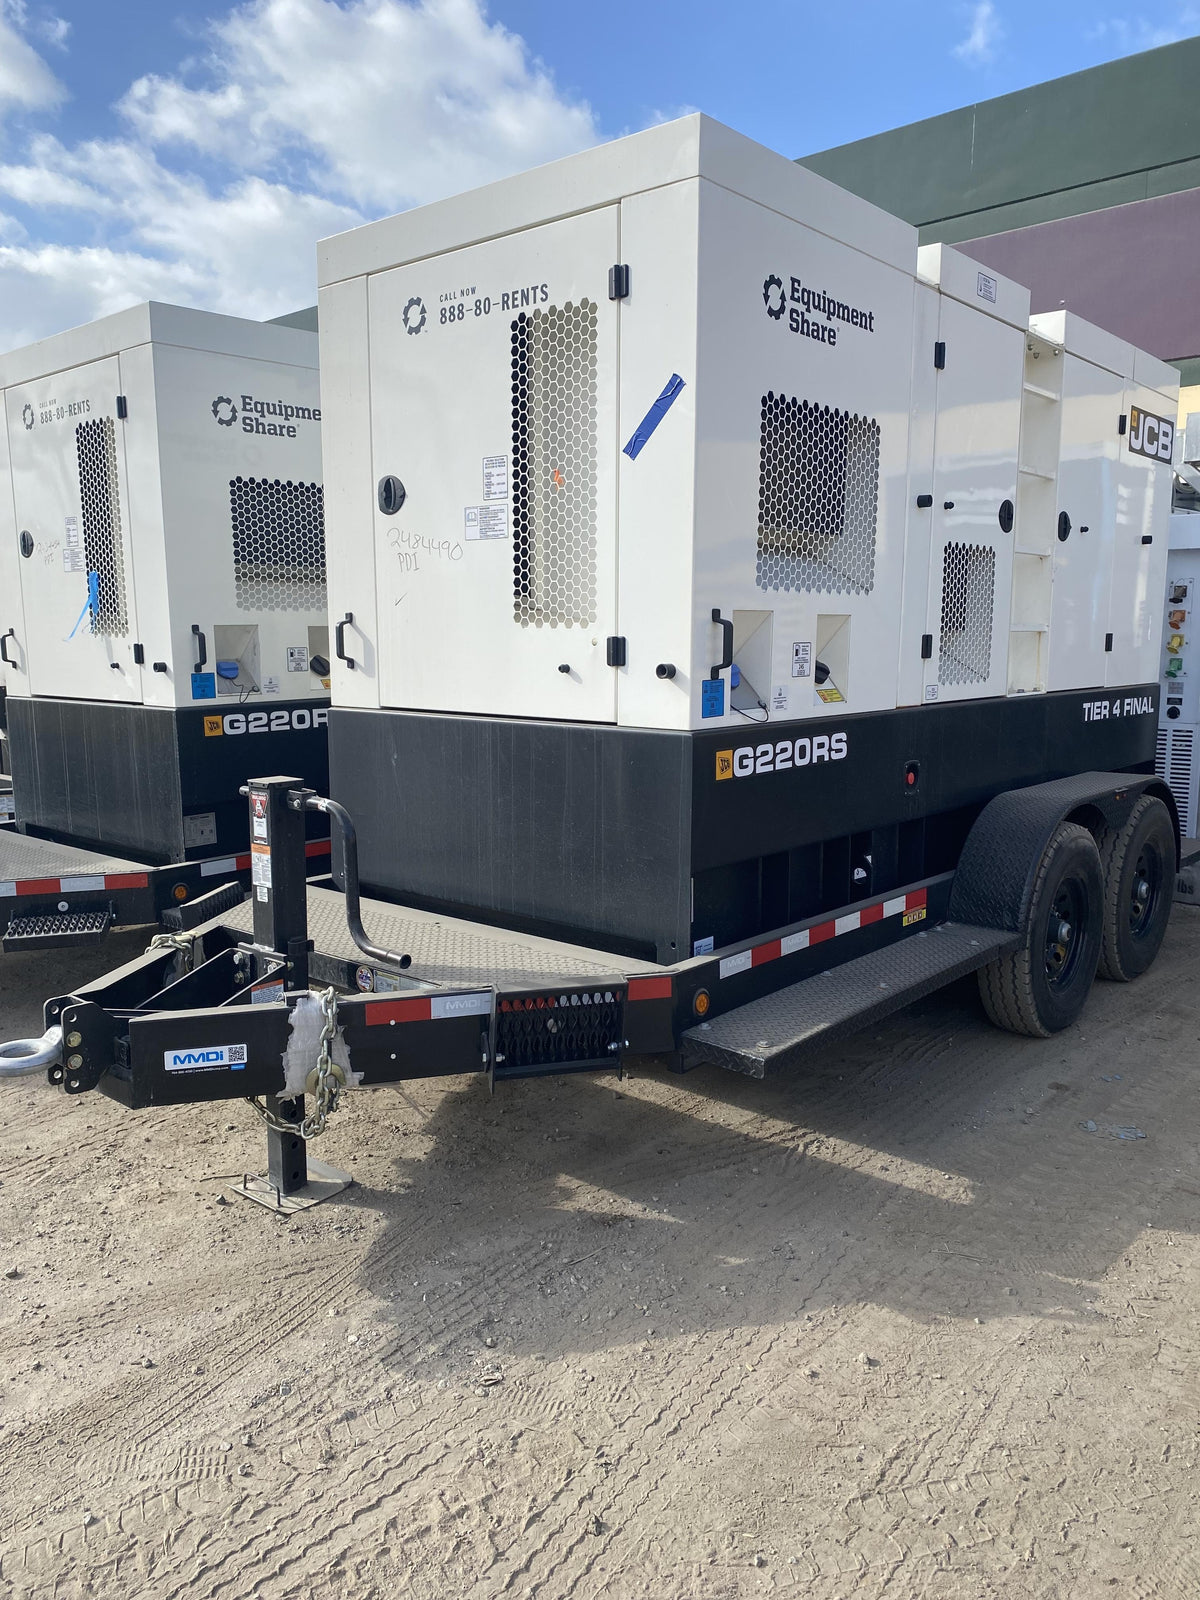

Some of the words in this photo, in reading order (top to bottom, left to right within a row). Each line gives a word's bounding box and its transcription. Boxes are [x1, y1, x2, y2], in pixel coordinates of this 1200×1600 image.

[440, 291, 457, 303] CALL
[460, 286, 477, 298] NOW
[440, 283, 549, 325] 888-80-RENTS
[789, 276, 875, 333] Equipment
[789, 307, 837, 347] Share
[40, 399, 91, 425] 888-80-RENTS
[241, 395, 322, 422] Equipme
[241, 416, 297, 439] Share
[1130, 412, 1173, 460] JCB
[386, 527, 463, 561] 2484490
[397, 552, 420, 573] PDI
[1082, 701, 1110, 722] TIER
[1112, 699, 1121, 717] 4
[1123, 696, 1155, 717] FINAL
[733, 732, 848, 778] G220RS
[1176, 878, 1194, 895] lbs
[172, 1050, 224, 1066] MMDi
